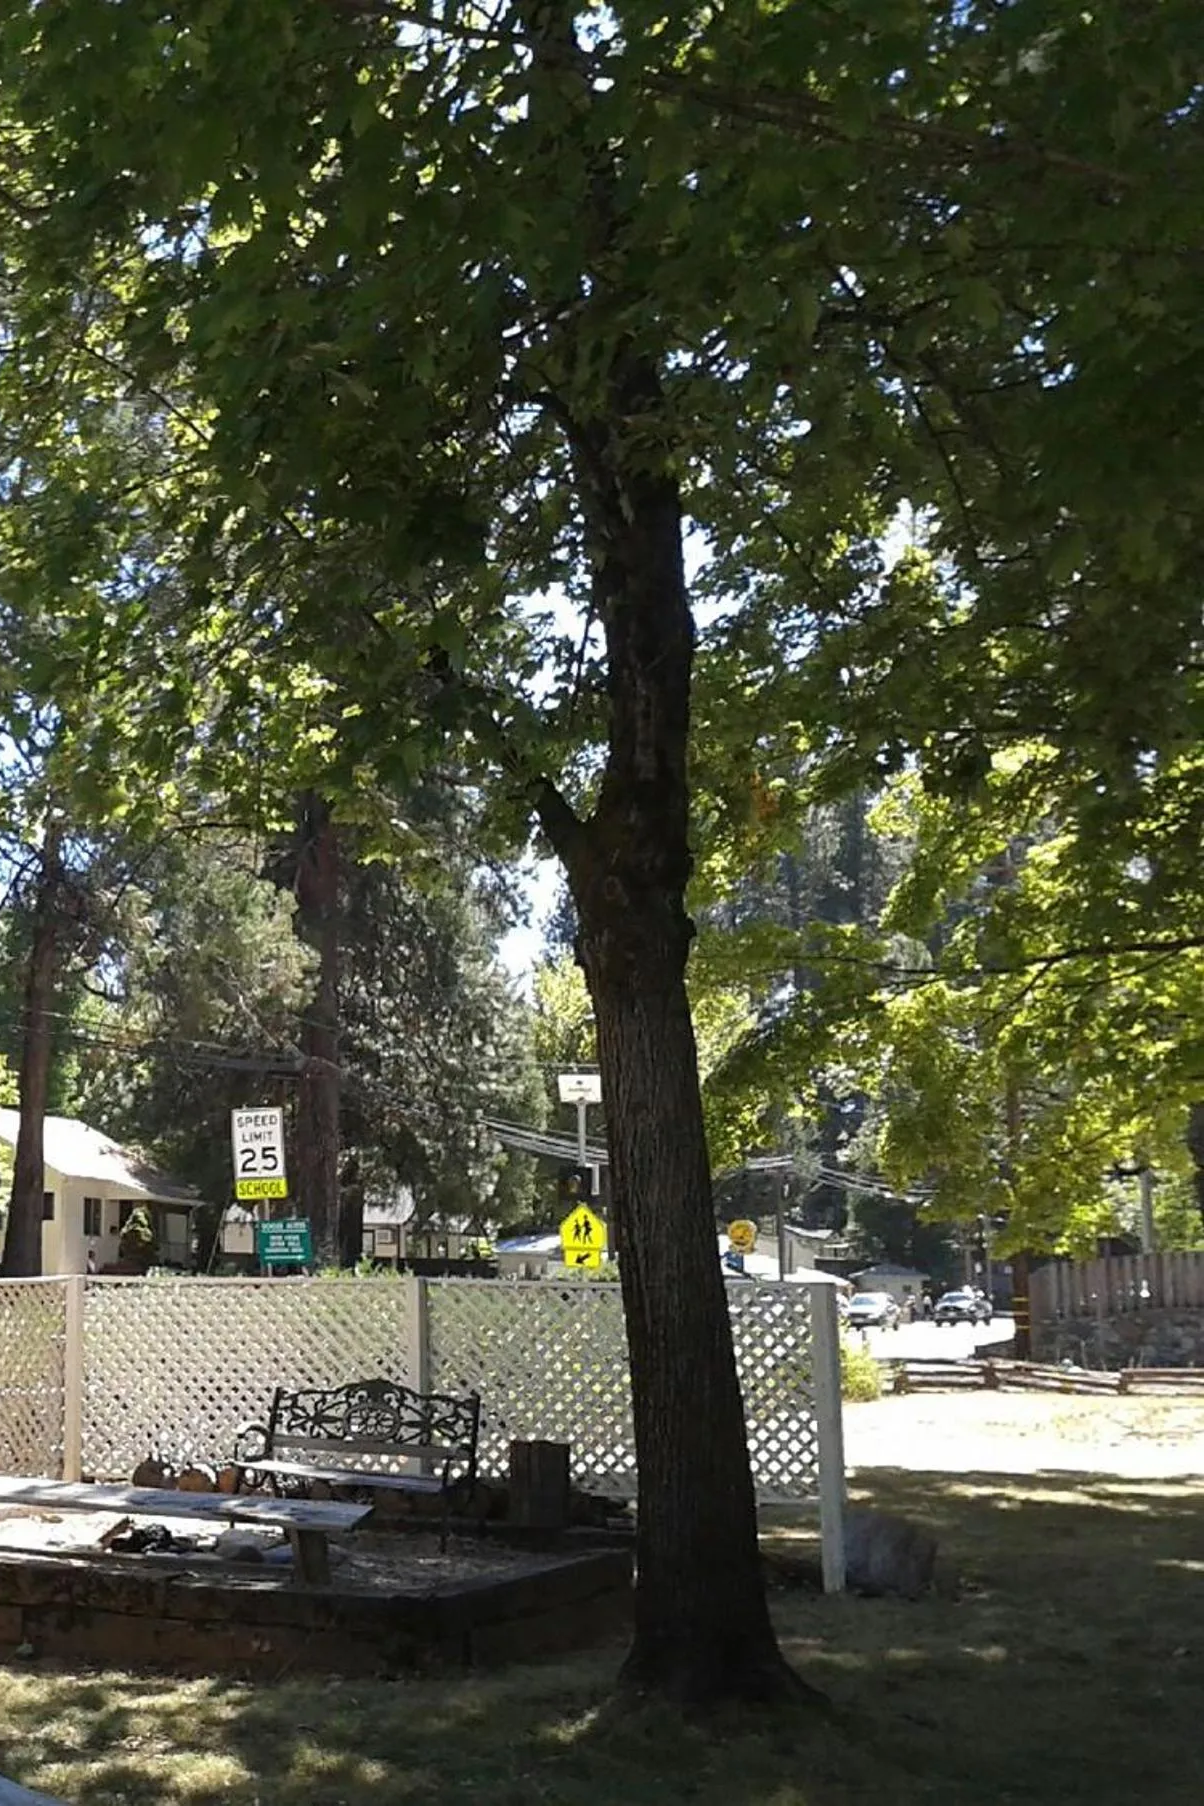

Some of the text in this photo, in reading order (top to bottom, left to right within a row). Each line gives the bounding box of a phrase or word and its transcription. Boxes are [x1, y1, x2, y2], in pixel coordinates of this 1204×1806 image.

[237, 1114, 278, 1128] SPEED
[242, 1131, 273, 1144] LIMIT
[240, 1146, 279, 1173] 25
[238, 1181, 284, 1197] SCHOOL
